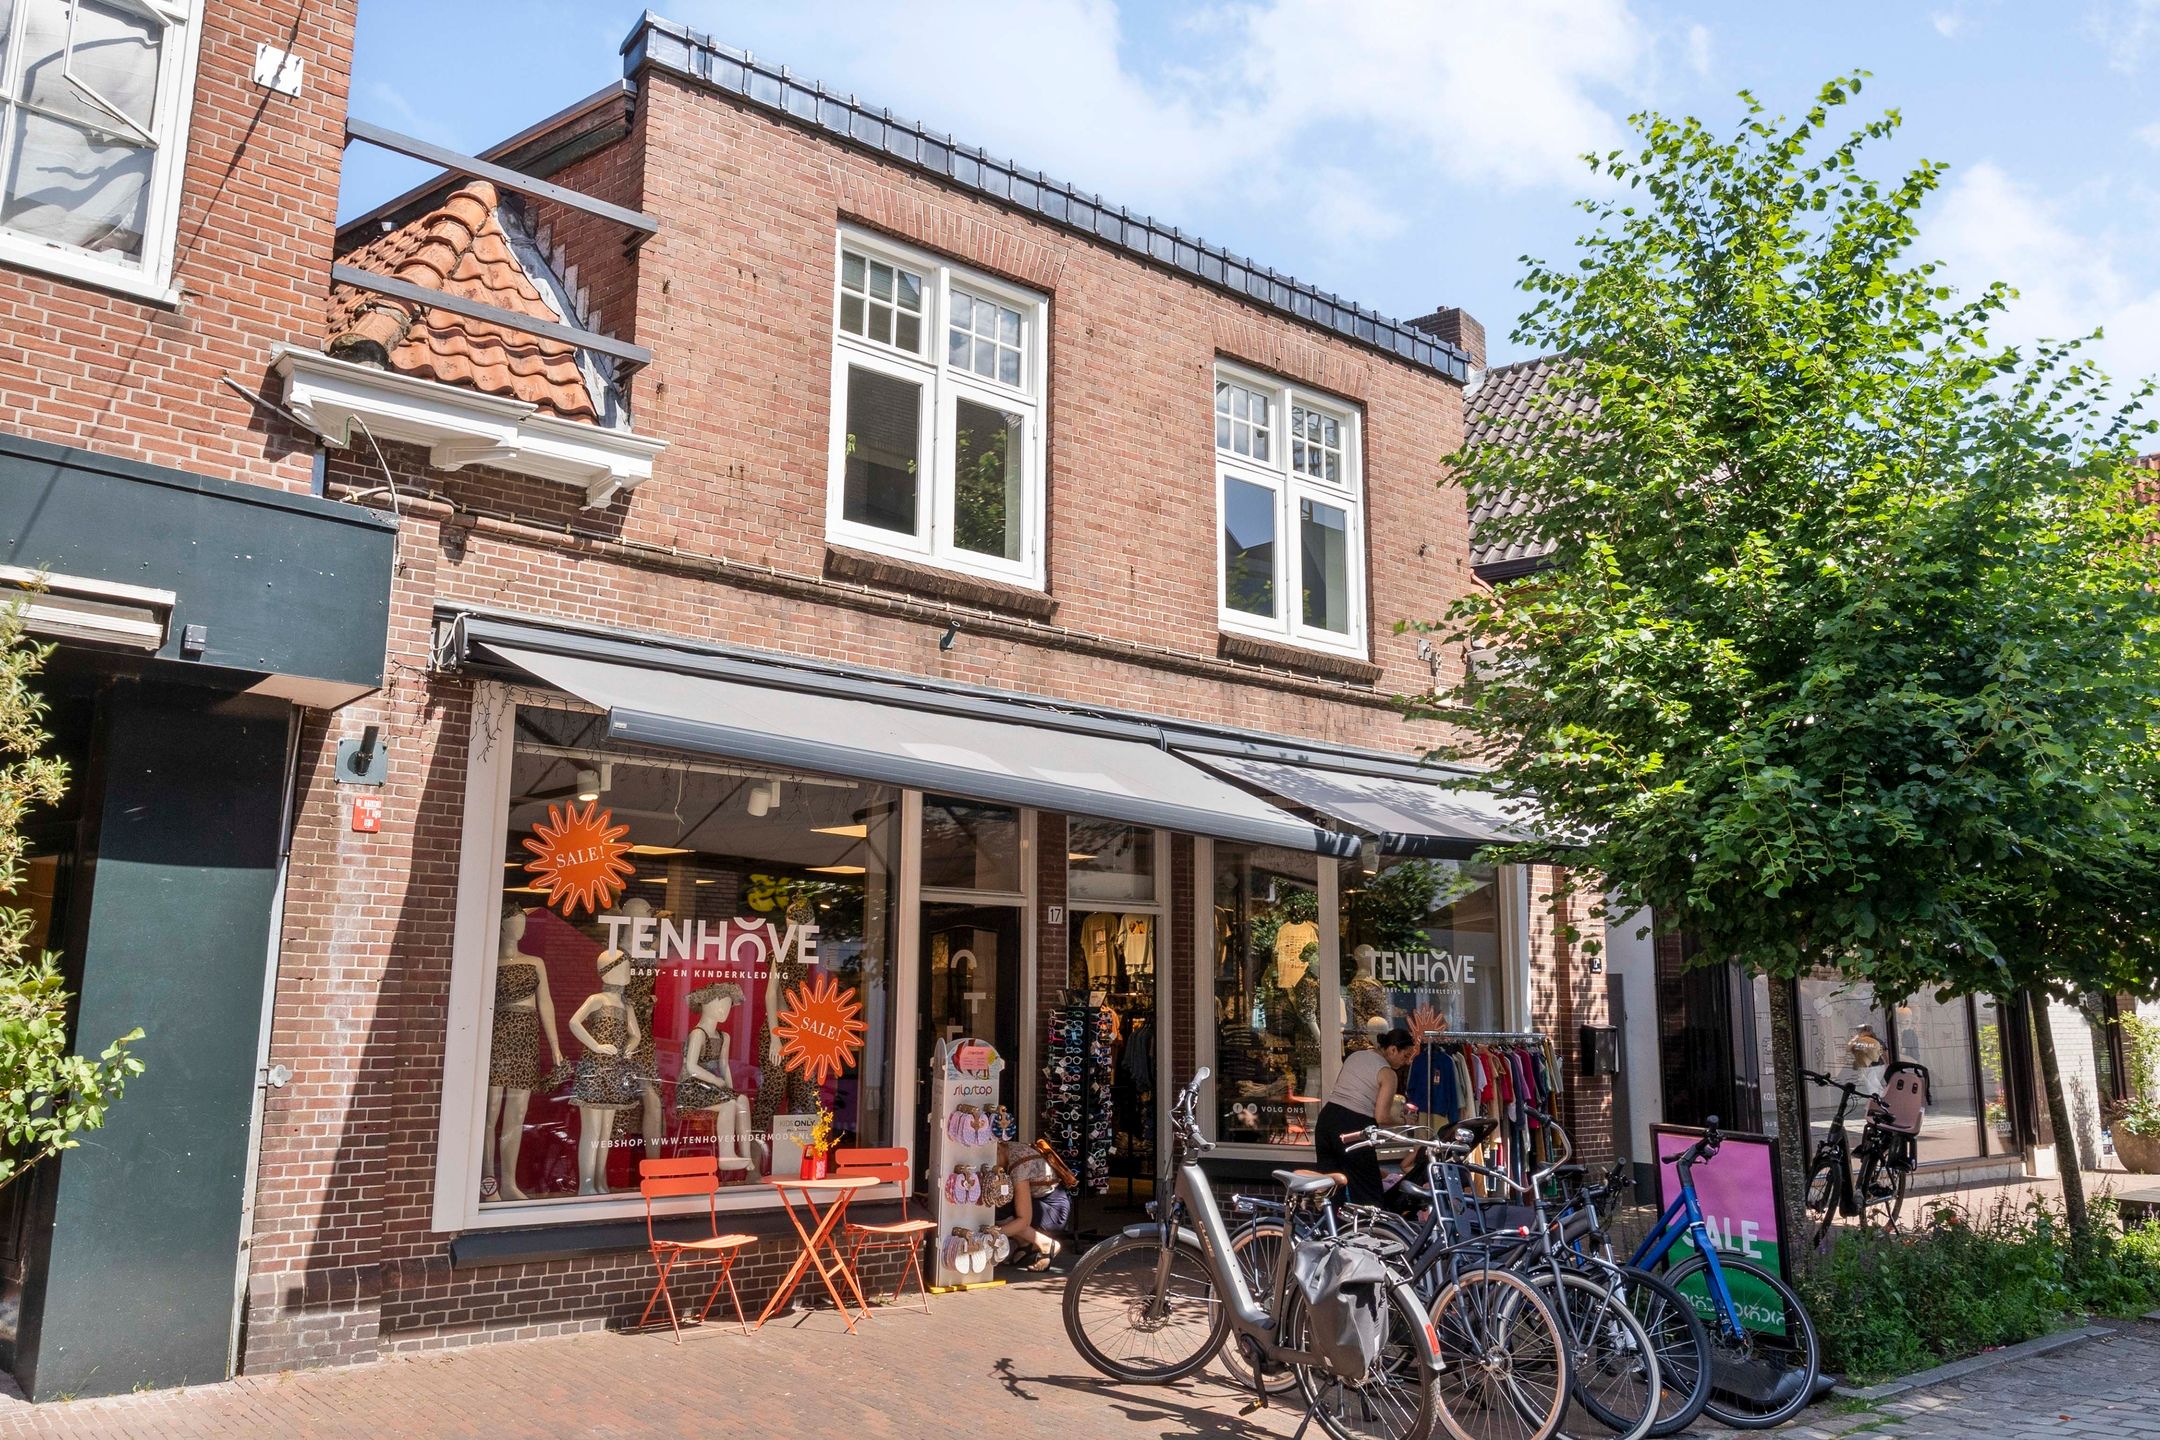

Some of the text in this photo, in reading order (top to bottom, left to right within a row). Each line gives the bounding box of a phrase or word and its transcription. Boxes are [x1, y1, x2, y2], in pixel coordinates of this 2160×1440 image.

[556, 845, 605, 868] SALE!
[1050, 908, 1061, 923] 17
[597, 914, 820, 964] TENHOVE
[630, 968, 789, 980] BABY- EN KINDERKLEDING
[1364, 948, 1476, 984] TENHOVE
[800, 1016, 842, 1042] SALE!
[953, 1084, 993, 1096] slipstop
[590, 1132, 811, 1149] WEBSHOP: WWW.TENHOVEKINDERMODNL
